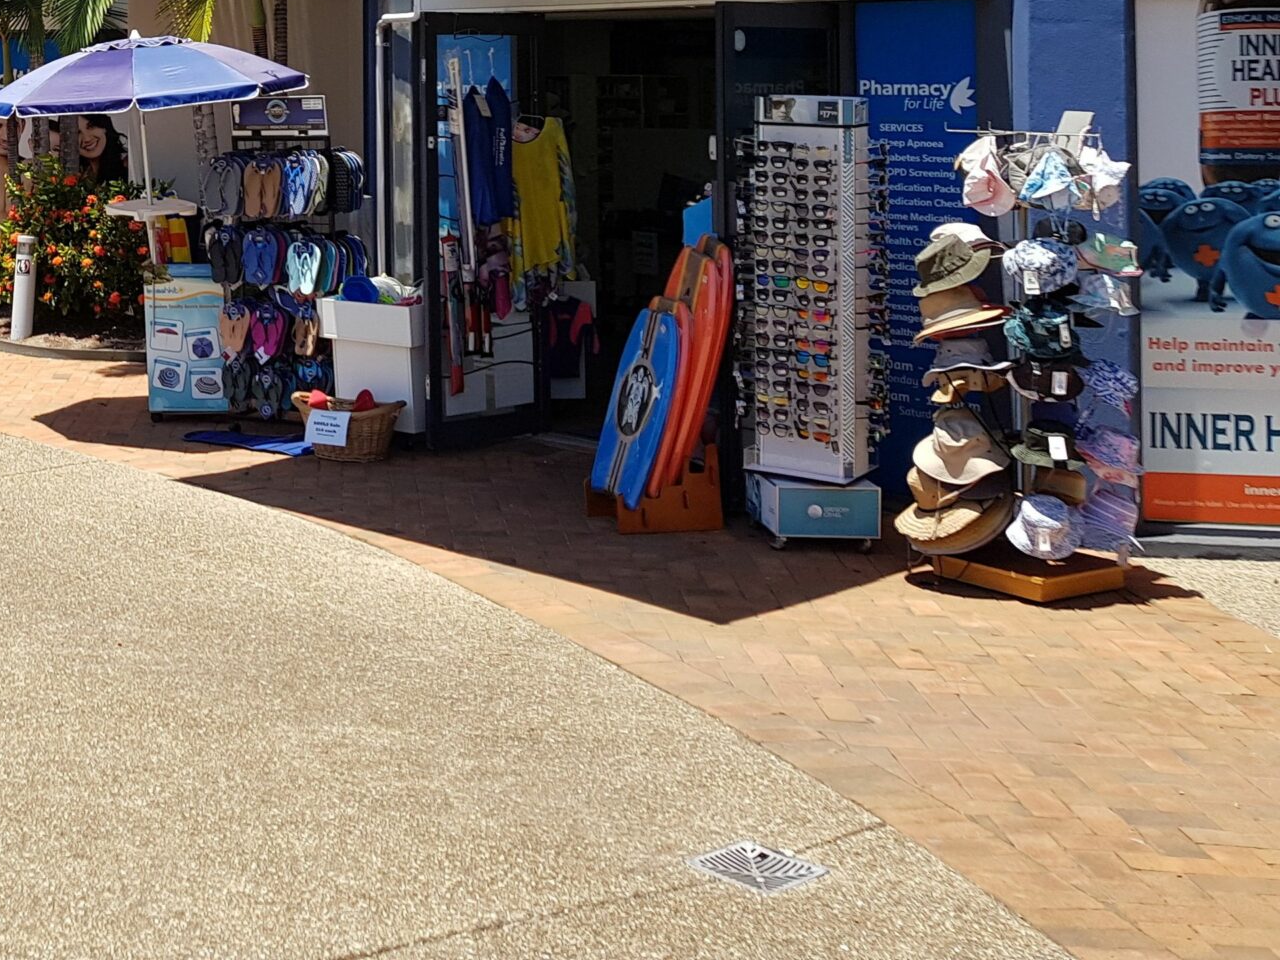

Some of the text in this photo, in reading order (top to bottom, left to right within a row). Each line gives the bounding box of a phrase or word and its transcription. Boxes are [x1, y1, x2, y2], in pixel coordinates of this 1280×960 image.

[1239, 34, 1280, 56] INN
[1231, 59, 1280, 82] HEA
[859, 79, 952, 100] Pharmacy
[904, 97, 945, 112] for Life
[879, 123, 924, 133] SERVICES
[907, 138, 944, 149] Apnoea
[886, 167, 956, 180] OPD Screening
[888, 183, 961, 194] edication Packs
[888, 197, 932, 207] edication
[910, 213, 963, 223] Medication
[1148, 337, 1274, 353] Help maintain
[1152, 359, 1186, 372] and
[1192, 359, 1265, 376] improve
[899, 406, 932, 418] Saturd
[1149, 411, 1257, 453] INNER
